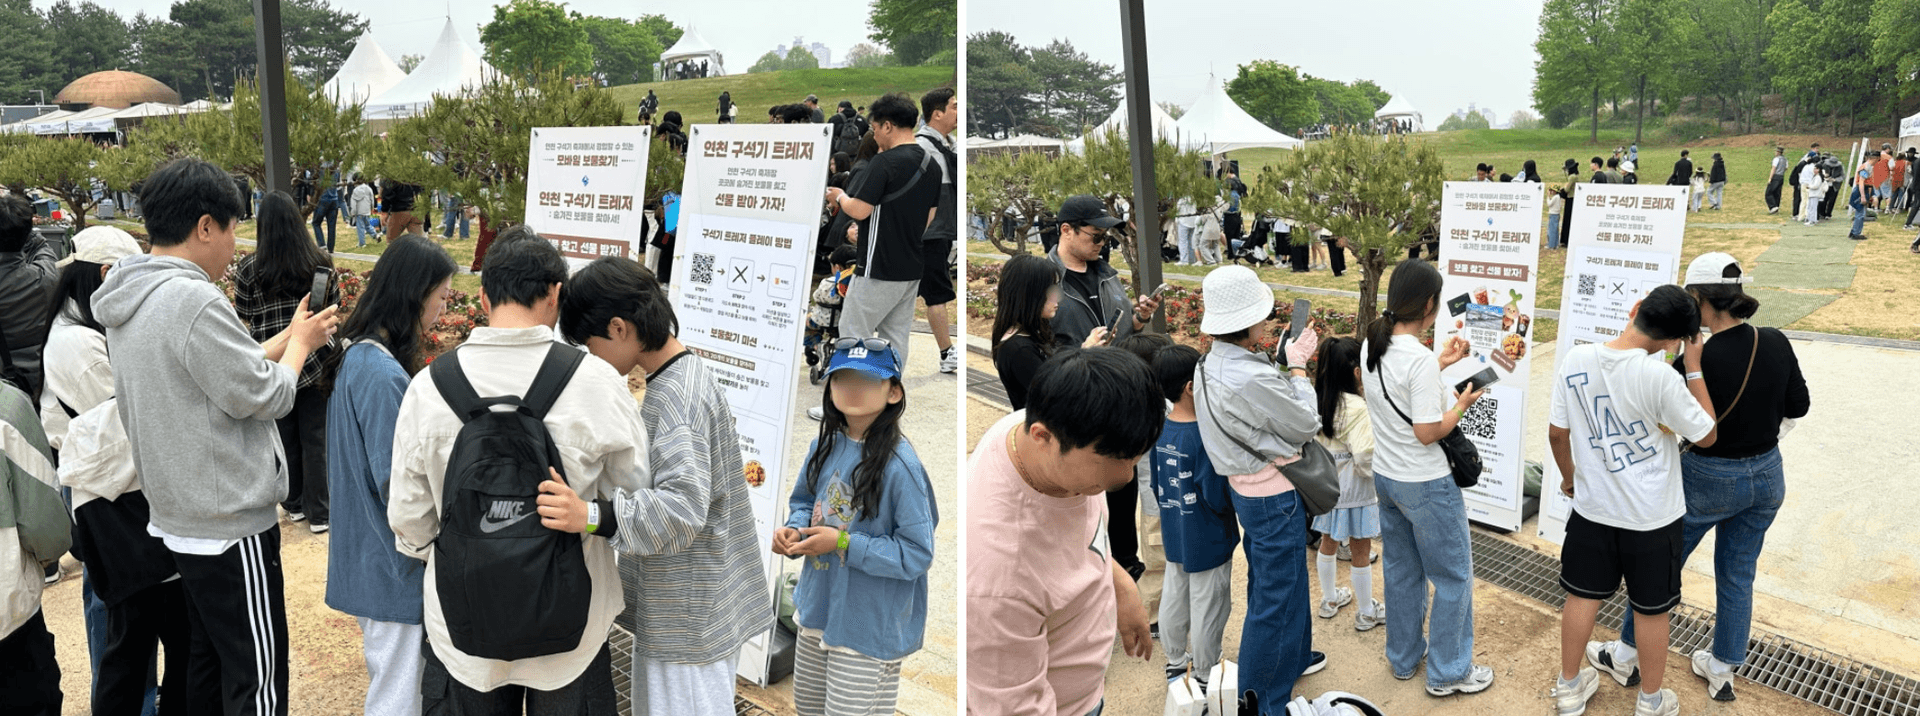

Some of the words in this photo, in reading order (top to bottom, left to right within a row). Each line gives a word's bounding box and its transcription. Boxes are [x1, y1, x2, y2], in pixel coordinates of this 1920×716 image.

[557, 143, 572, 151] 구석기
[704, 140, 728, 158] 연천
[732, 141, 768, 159] 구석기
[771, 141, 814, 160] 트레저
[557, 154, 580, 166] 모바일
[582, 155, 618, 167] 보물찾기!
[740, 168, 757, 177] 구석기
[539, 191, 560, 206] 연천
[564, 193, 595, 209] 구석기
[598, 194, 633, 211] 트레저
[715, 193, 734, 206] 선물
[737, 194, 757, 209] 받아
[760, 196, 786, 212] 가자!
[1465, 202, 1486, 211] 모바일
[1488, 202, 1518, 212] 보물찾기!
[1586, 195, 1606, 207] 연천
[1609, 196, 1639, 209] 구석기
[1641, 196, 1675, 210] 트레저
[702, 228, 723, 240] 구석기
[724, 231, 747, 244] 트레저
[749, 234, 773, 247] 플레이
[775, 237, 793, 249] 방법
[1451, 229, 1469, 240] 연천
[1472, 230, 1498, 242] 구석기
[1501, 231, 1531, 244] 트레저
[1596, 232, 1612, 242] 선물
[1614, 233, 1630, 243] 받아
[1633, 234, 1653, 245] 가자!
[1454, 263, 1468, 273] 보물
[1470, 264, 1484, 274] 찾고
[710, 327, 740, 343] 보물찾기
[741, 335, 758, 348] 미션
[1566, 372, 1657, 473] LA
[487, 501, 525, 518] NIKE
